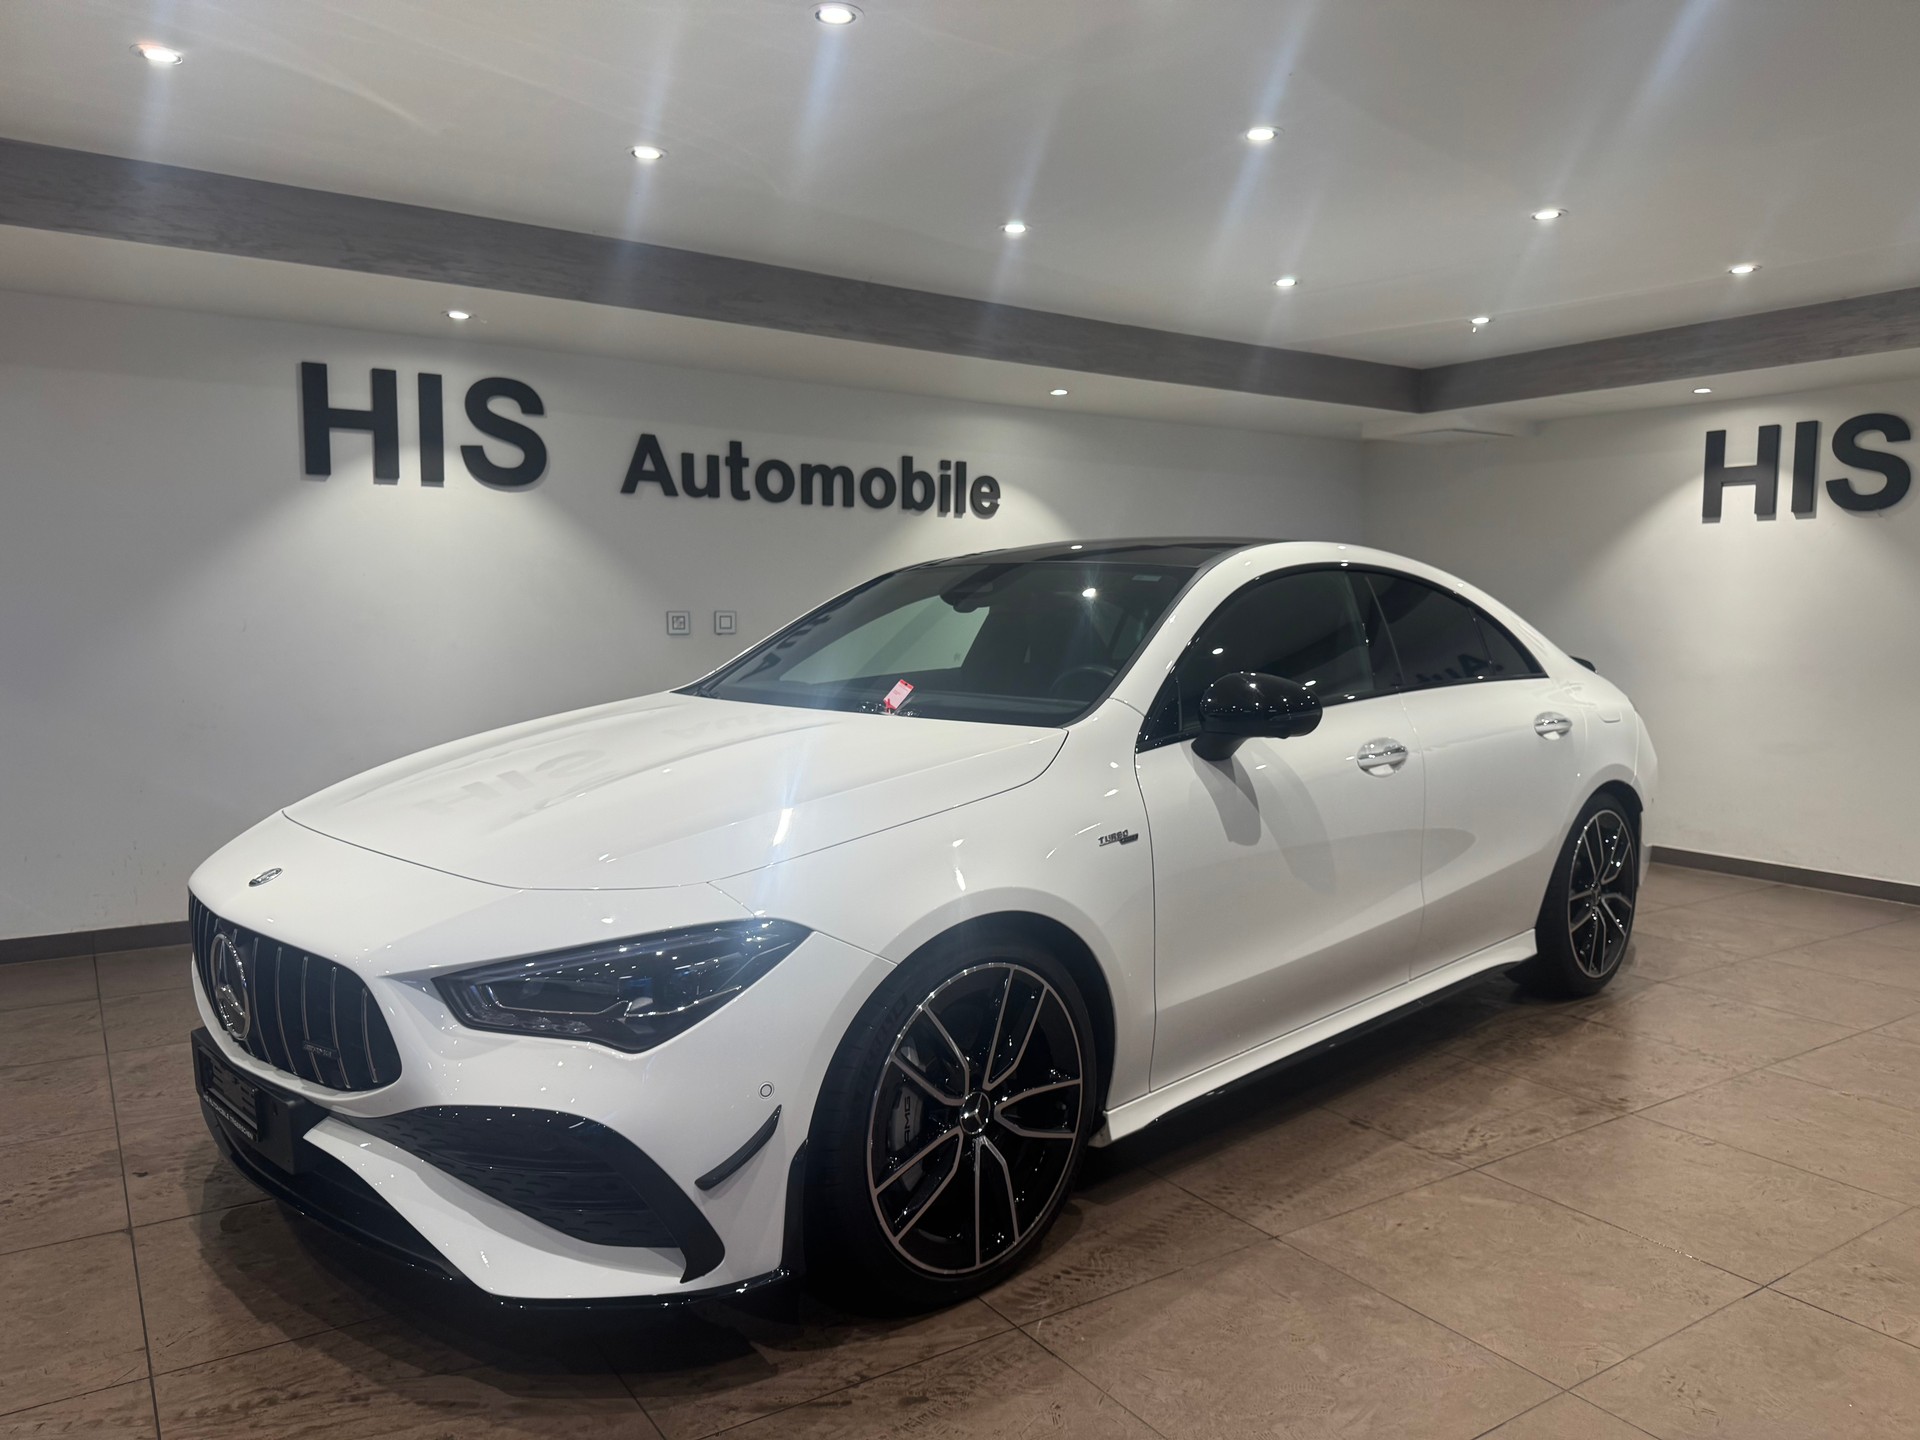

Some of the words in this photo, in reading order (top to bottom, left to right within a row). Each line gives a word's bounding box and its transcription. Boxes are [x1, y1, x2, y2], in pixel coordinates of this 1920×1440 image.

[300, 361, 548, 488] HIS
[620, 433, 1002, 518] Automobile
[1702, 412, 1913, 519] HIS
[1098, 829, 1128, 845] TURBO
